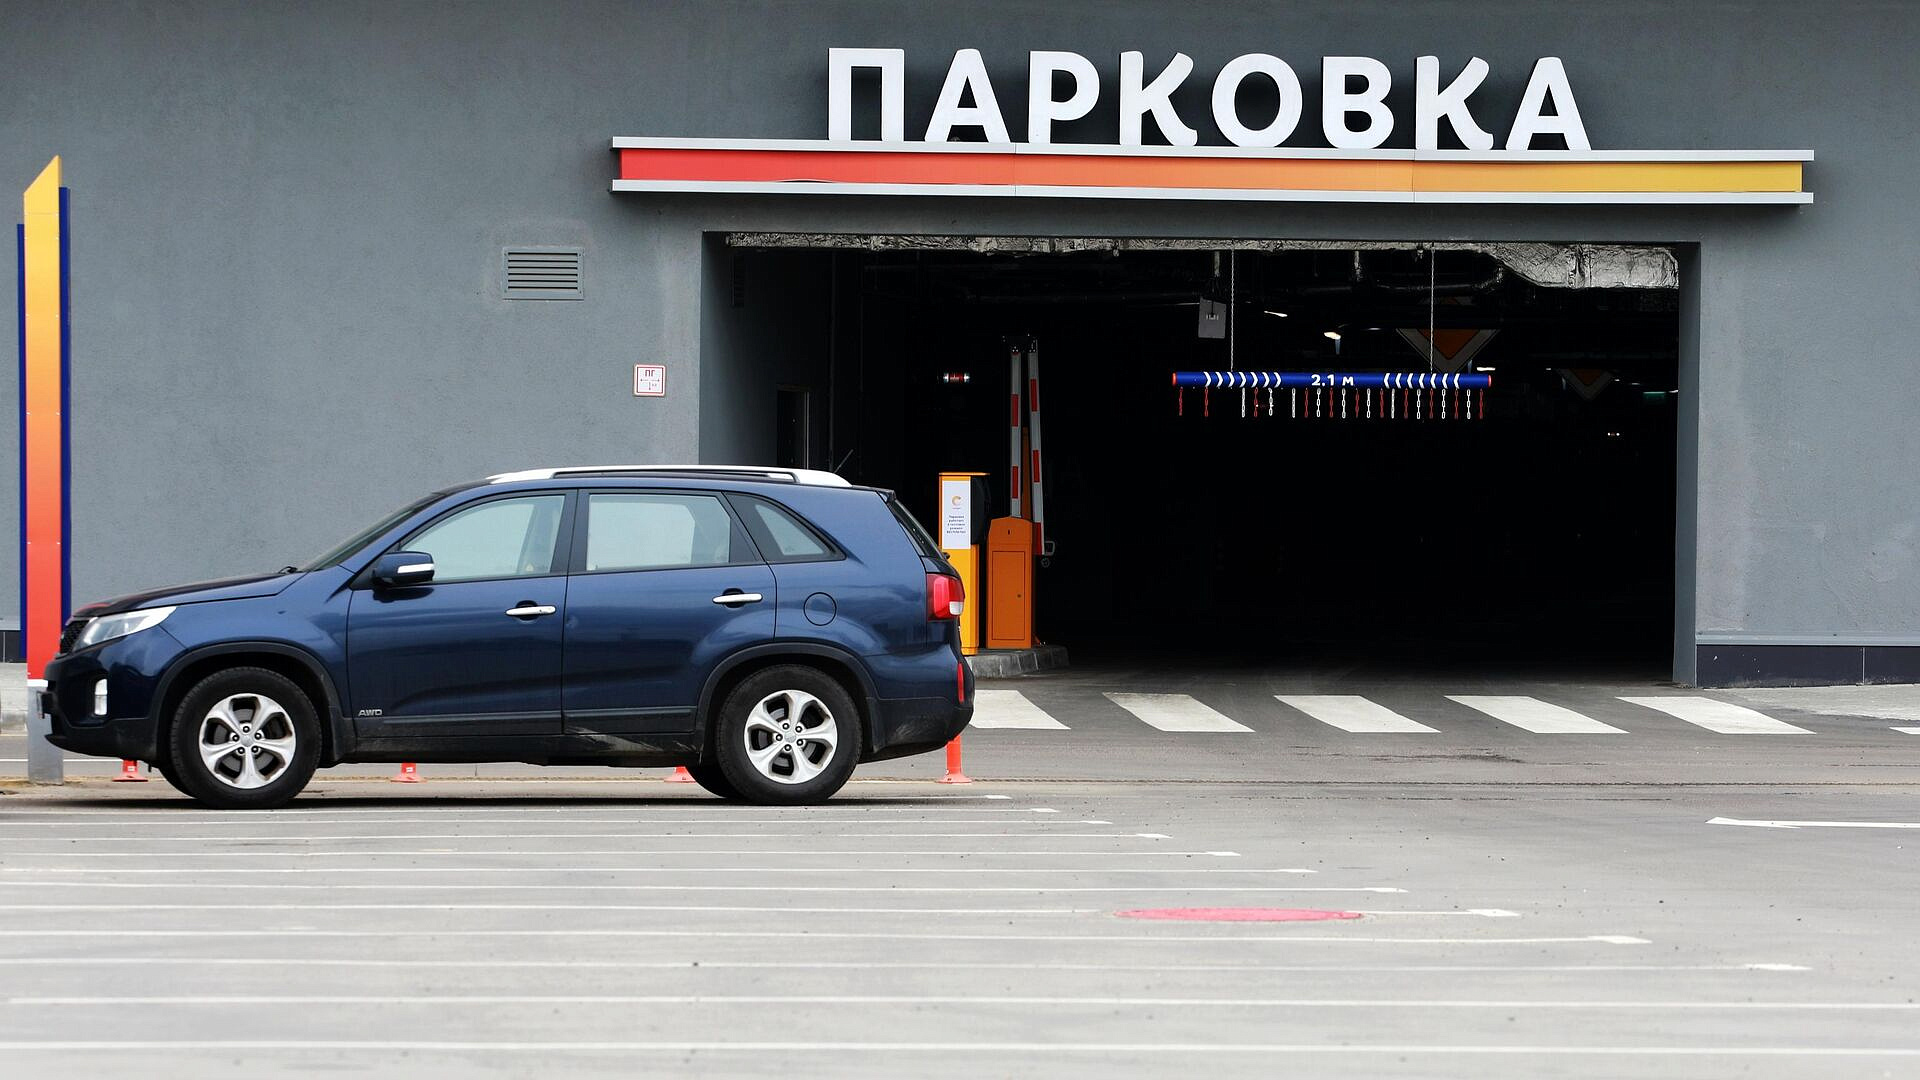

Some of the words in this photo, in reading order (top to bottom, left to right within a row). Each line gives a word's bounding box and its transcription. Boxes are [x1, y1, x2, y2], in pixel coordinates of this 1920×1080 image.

[827, 47, 1592, 151] ПАРКОВКА
[645, 369, 655, 377] ПГ
[1311, 374, 1335, 387] 2.1
[358, 709, 383, 717] AWD
